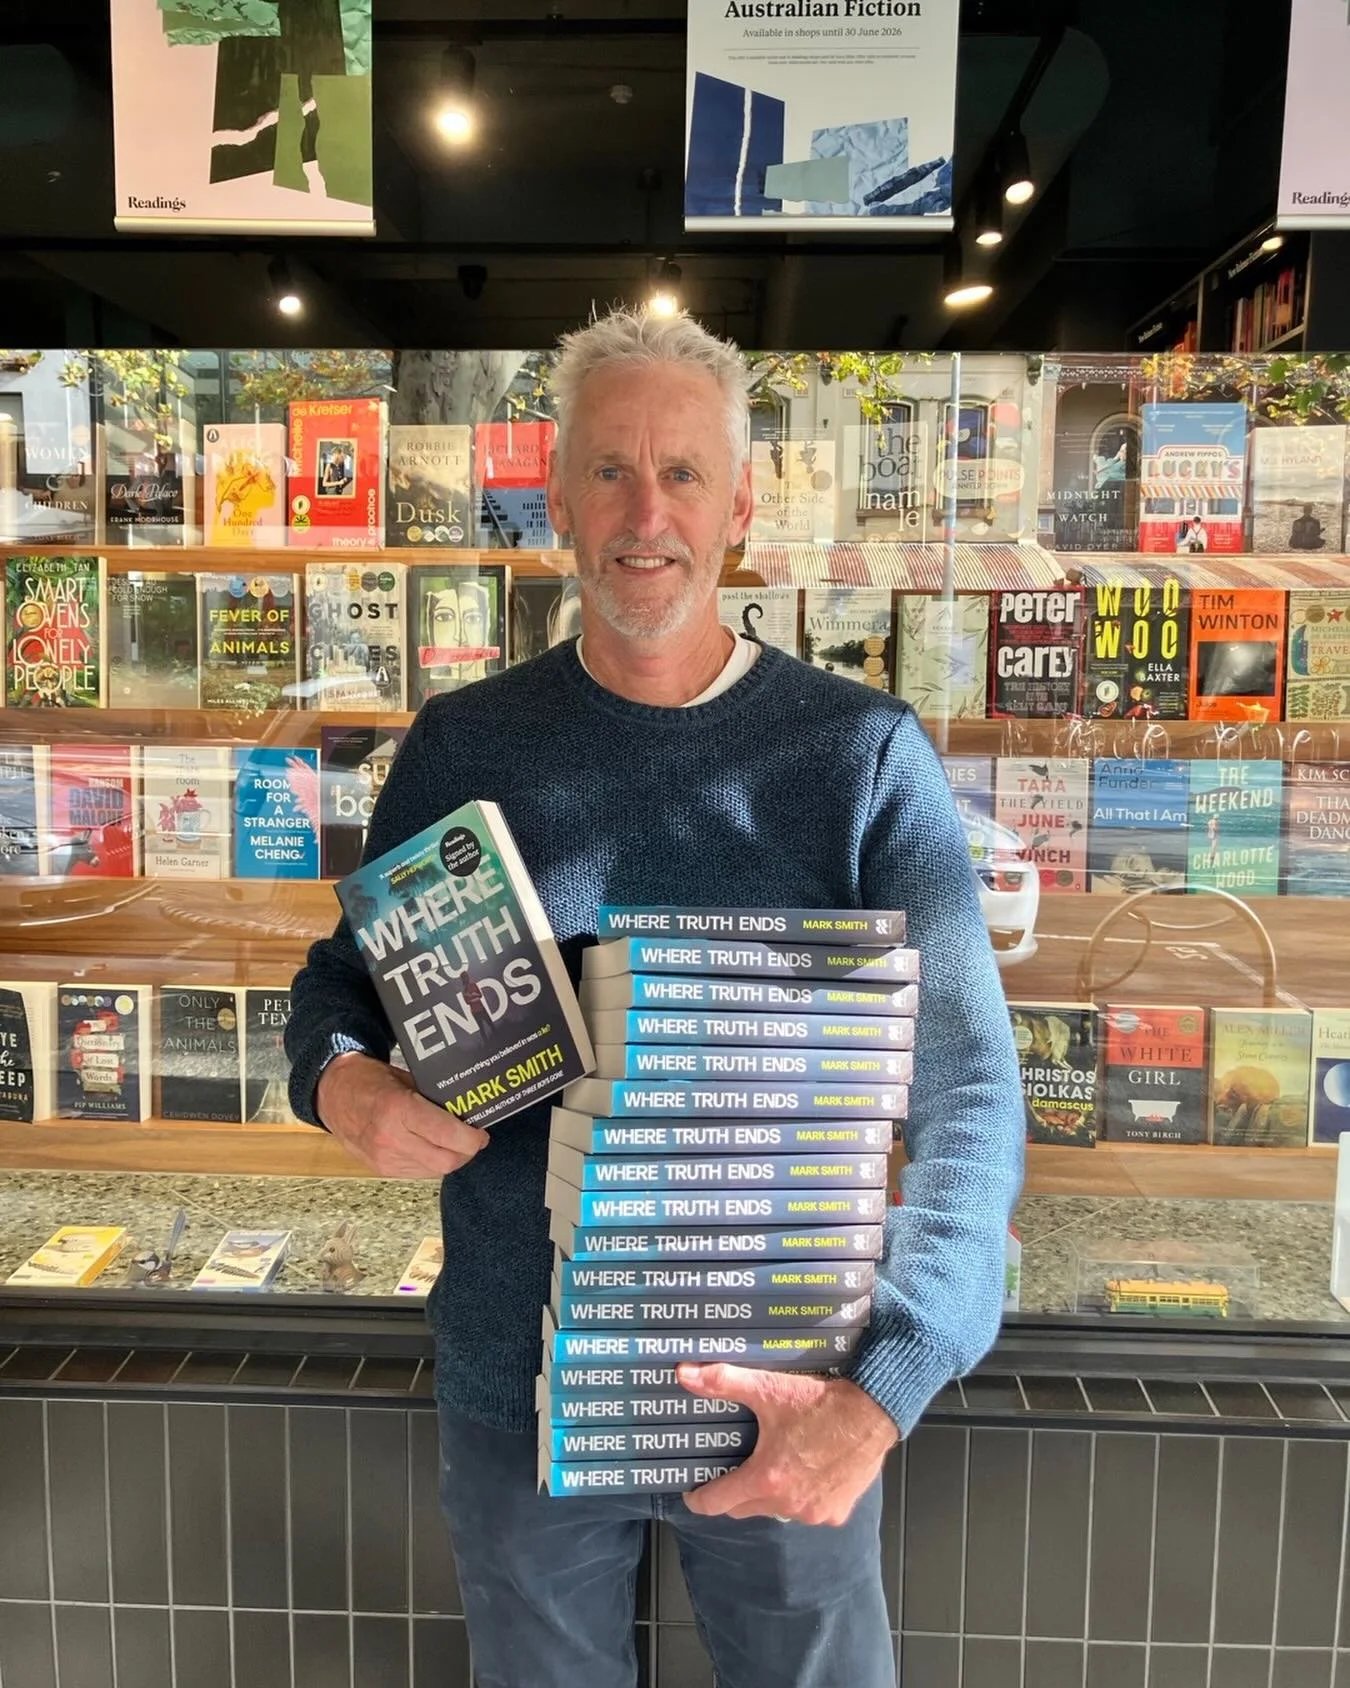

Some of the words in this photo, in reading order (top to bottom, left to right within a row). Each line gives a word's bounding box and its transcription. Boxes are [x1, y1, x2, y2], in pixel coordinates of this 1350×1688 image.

[725, 0, 839, 18] Australian
[844, 0, 922, 18] Fiction
[743, 28, 783, 38] Available
[784, 28, 794, 38] in
[795, 28, 820, 39] shops
[822, 28, 843, 38] until
[846, 28, 856, 37] 30
[858, 28, 879, 37] June
[881, 28, 902, 37] 2026
[128, 197, 187, 211] Readings
[399, 455, 462, 465] ARNOTT
[1148, 459, 1241, 479] LUCKY'S
[111, 482, 144, 498] Dark
[1047, 490, 1121, 500] MIDNIGHT
[395, 500, 462, 523] Dusk
[1058, 513, 1108, 522] WATCH
[16, 563, 67, 572] ELIZABETH
[73, 562, 90, 572] TAN
[25, 577, 86, 602] SMART
[740, 591, 752, 600] the
[1096, 577, 1180, 617] WOO
[1199, 595, 1235, 610] TIM
[16, 601, 91, 632] OVENS
[209, 609, 262, 622] FEVER
[266, 609, 290, 622] OF
[310, 603, 398, 619] GHOST
[809, 616, 889, 632] Wimmera
[1199, 614, 1279, 630] WINTON
[44, 628, 64, 640] FOR
[1094, 620, 1178, 660] WOO
[13, 635, 91, 667] LONELY
[210, 641, 290, 654] ANIMALS
[1147, 663, 1173, 672] ELLA
[14, 662, 96, 693] PEOPLE
[176, 777, 200, 786] room
[1218, 766, 1250, 787] THE
[1297, 769, 1326, 782] KIM
[1332, 769, 1350, 782] SC
[254, 779, 291, 789] ROOM
[1017, 779, 1066, 792] TARA
[266, 793, 291, 803] FOR
[1000, 799, 1028, 809] THE
[1042, 799, 1084, 810] YIELD
[1195, 788, 1274, 814] WEEKEND
[274, 806, 284, 815] A
[1094, 808, 1113, 820] All
[1115, 808, 1151, 820] That
[1153, 808, 1158, 820] I
[1160, 809, 1188, 822] Am
[244, 817, 311, 828] STRANGER
[1017, 815, 1065, 828] JUNE
[250, 836, 305, 847] MELANIE
[255, 849, 300, 860] CHENG
[444, 846, 467, 863] Signed
[466, 841, 476, 851] by
[447, 861, 459, 871] the
[459, 848, 480, 865] author
[1193, 845, 1275, 870] CHARLOTTE
[155, 856, 179, 866] Helen
[181, 857, 209, 867] Garner
[1216, 870, 1255, 889] WOOD
[358, 853, 505, 962] WHERE
[608, 913, 670, 930] WHERE
[676, 915, 733, 932] TRUTH
[739, 916, 787, 932] ENDS
[803, 919, 833, 930] MARK
[834, 920, 868, 930] SMITH
[382, 905, 521, 1007] TRUTH
[641, 947, 701, 965] WHERE
[707, 949, 762, 967] TRUTH
[768, 951, 812, 968] ENDS
[827, 956, 854, 967] MARK
[854, 957, 887, 968] SMITH
[179, 994, 220, 1009] ONLY
[402, 958, 542, 1062] ENDS
[184, 1016, 216, 1031] THE
[638, 1017, 698, 1034] WHERE
[703, 1019, 758, 1036] TRUTH
[764, 1020, 808, 1037] ENDS
[822, 1025, 850, 1036] MARK
[851, 1026, 881, 1037] SMITH
[163, 1037, 236, 1054] ANIMALS
[95, 1057, 114, 1065] Lost
[436, 1077, 454, 1090] What
[453, 1072, 460, 1081] if
[459, 1058, 491, 1080] everything
[490, 1053, 501, 1065] you
[499, 1039, 522, 1058] believed
[526, 1032, 538, 1042] was
[1120, 1047, 1193, 1063] WHITE
[86, 1072, 113, 1081] Words
[445, 1075, 507, 1117] MARK
[506, 1044, 564, 1088] SMITH
[1128, 1070, 1181, 1086] GIRL
[495, 1096, 516, 1111] AUTHOR
[514, 1092, 522, 1100] OF
[522, 1085, 537, 1096] THREE
[537, 1077, 552, 1089] BOYS
[549, 1070, 564, 1082] GONE
[88, 1102, 126, 1110] WILLIAMS
[624, 1091, 686, 1108] WHERE
[691, 1092, 747, 1108] TRUTH
[752, 1093, 799, 1109] ENDS
[813, 1095, 842, 1106] MARK
[843, 1095, 874, 1107] SMITH
[1031, 1098, 1094, 1112] damascus
[1126, 1130, 1150, 1138] TONY
[1152, 1131, 1182, 1139] BIRCH
[595, 1164, 659, 1181] WHERE
[664, 1164, 722, 1180] TRUTH
[727, 1163, 774, 1179] ENDS
[790, 1165, 819, 1176] MARK
[820, 1165, 852, 1176] SMITH
[584, 1236, 648, 1253] WHERE
[654, 1235, 713, 1251] TRUTH
[719, 1234, 766, 1251] ENDS
[782, 1237, 812, 1248] MARK
[813, 1236, 846, 1247] SMITH
[570, 1304, 634, 1320] WHERE
[641, 1304, 698, 1320] TRUTH
[704, 1303, 752, 1319] ENDS
[768, 1305, 799, 1316] MARK
[800, 1305, 833, 1316] SMITH
[565, 1339, 629, 1356] WHERE
[635, 1338, 693, 1354] TRUTH
[698, 1337, 747, 1353] ENDS
[762, 1339, 793, 1349] MARK
[794, 1338, 826, 1349] SMITH
[561, 1471, 624, 1487] WHERE
[630, 1468, 688, 1485] TRUTH
